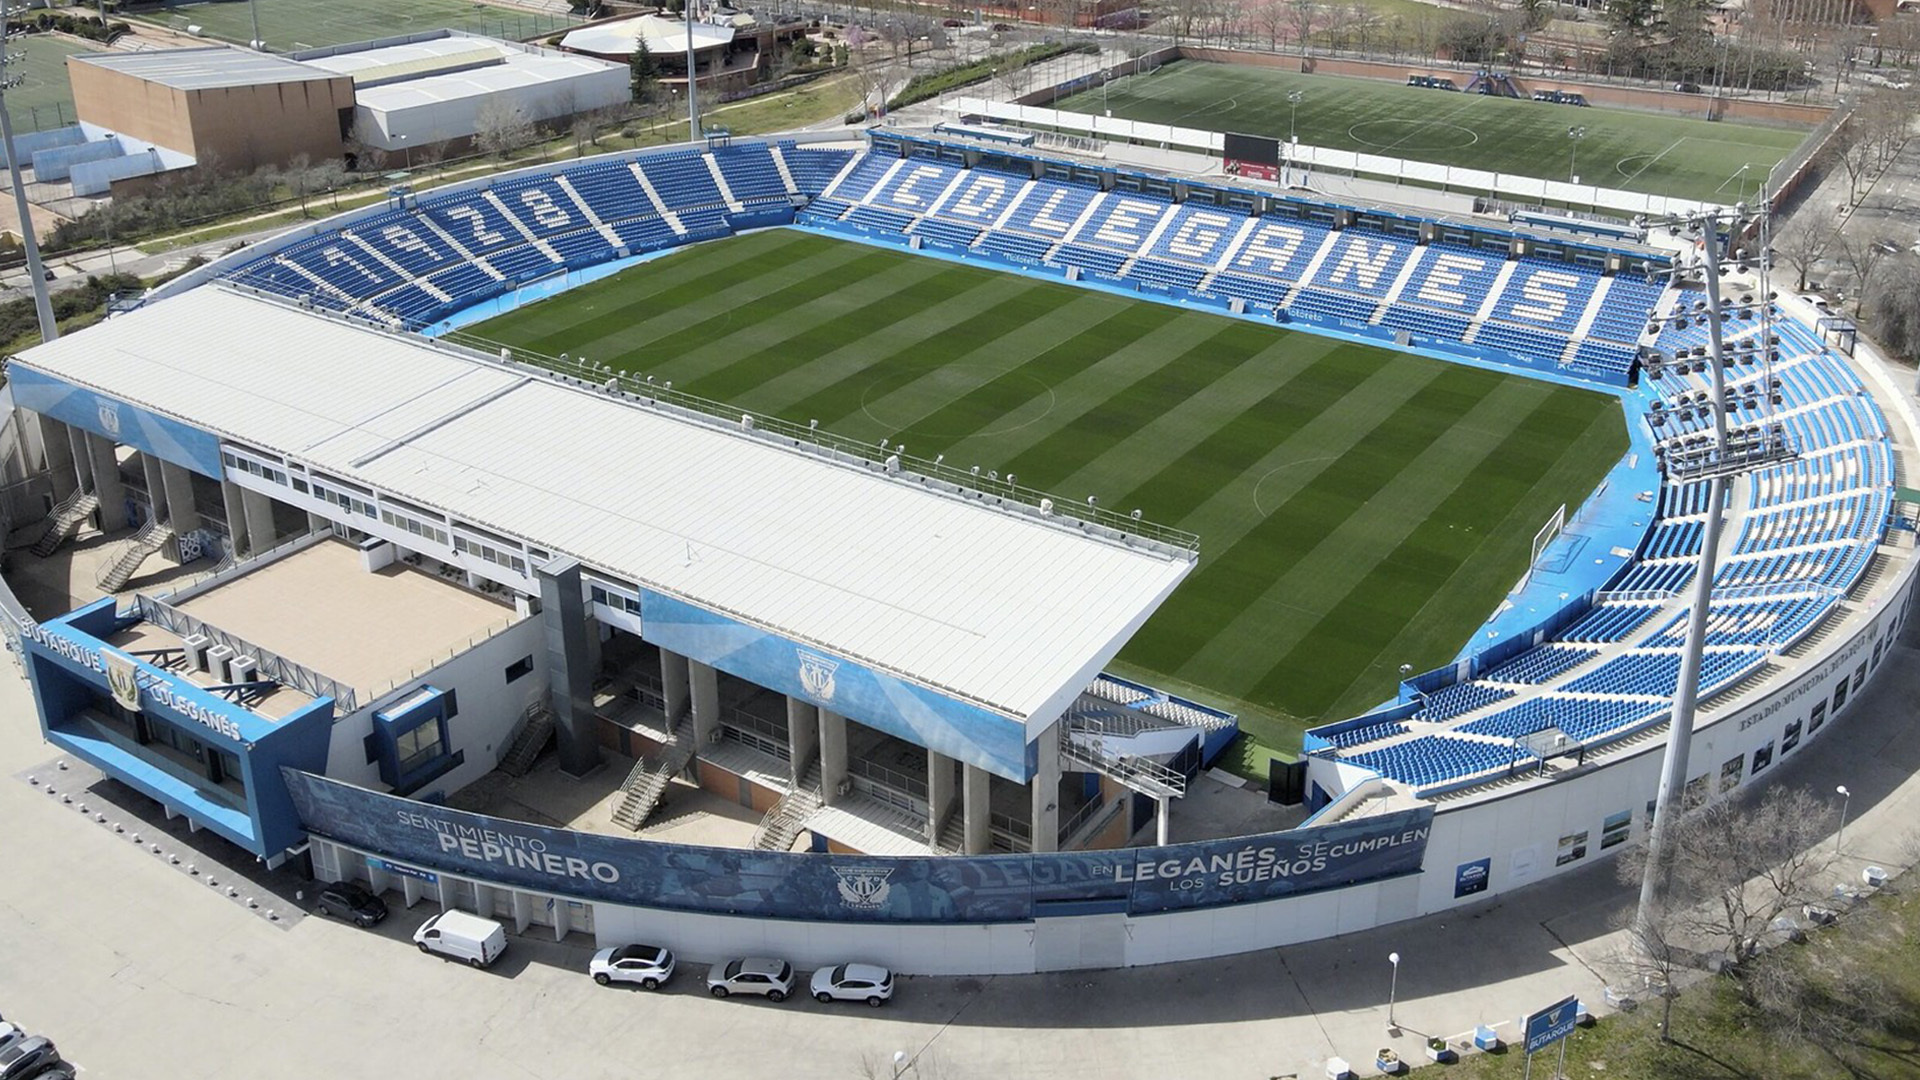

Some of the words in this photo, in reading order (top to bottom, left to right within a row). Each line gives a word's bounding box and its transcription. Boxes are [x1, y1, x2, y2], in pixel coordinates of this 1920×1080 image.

[323, 188, 570, 284] 1928
[20, 616, 102, 673] BUTARQUE
[1738, 701, 1781, 732] ESTADIO
[397, 810, 547, 853] SENTIMIENTO
[1092, 865, 1113, 876] EN
[1115, 846, 1276, 883] LEGANÉS
[1298, 841, 1330, 860] SE
[1329, 827, 1430, 859] CUMPLEN
[438, 832, 620, 884] PEPINERO
[1170, 877, 1205, 891] LOS
[1219, 857, 1327, 887] SUEÑOS
[1529, 1020, 1575, 1050] BUTARQUE
